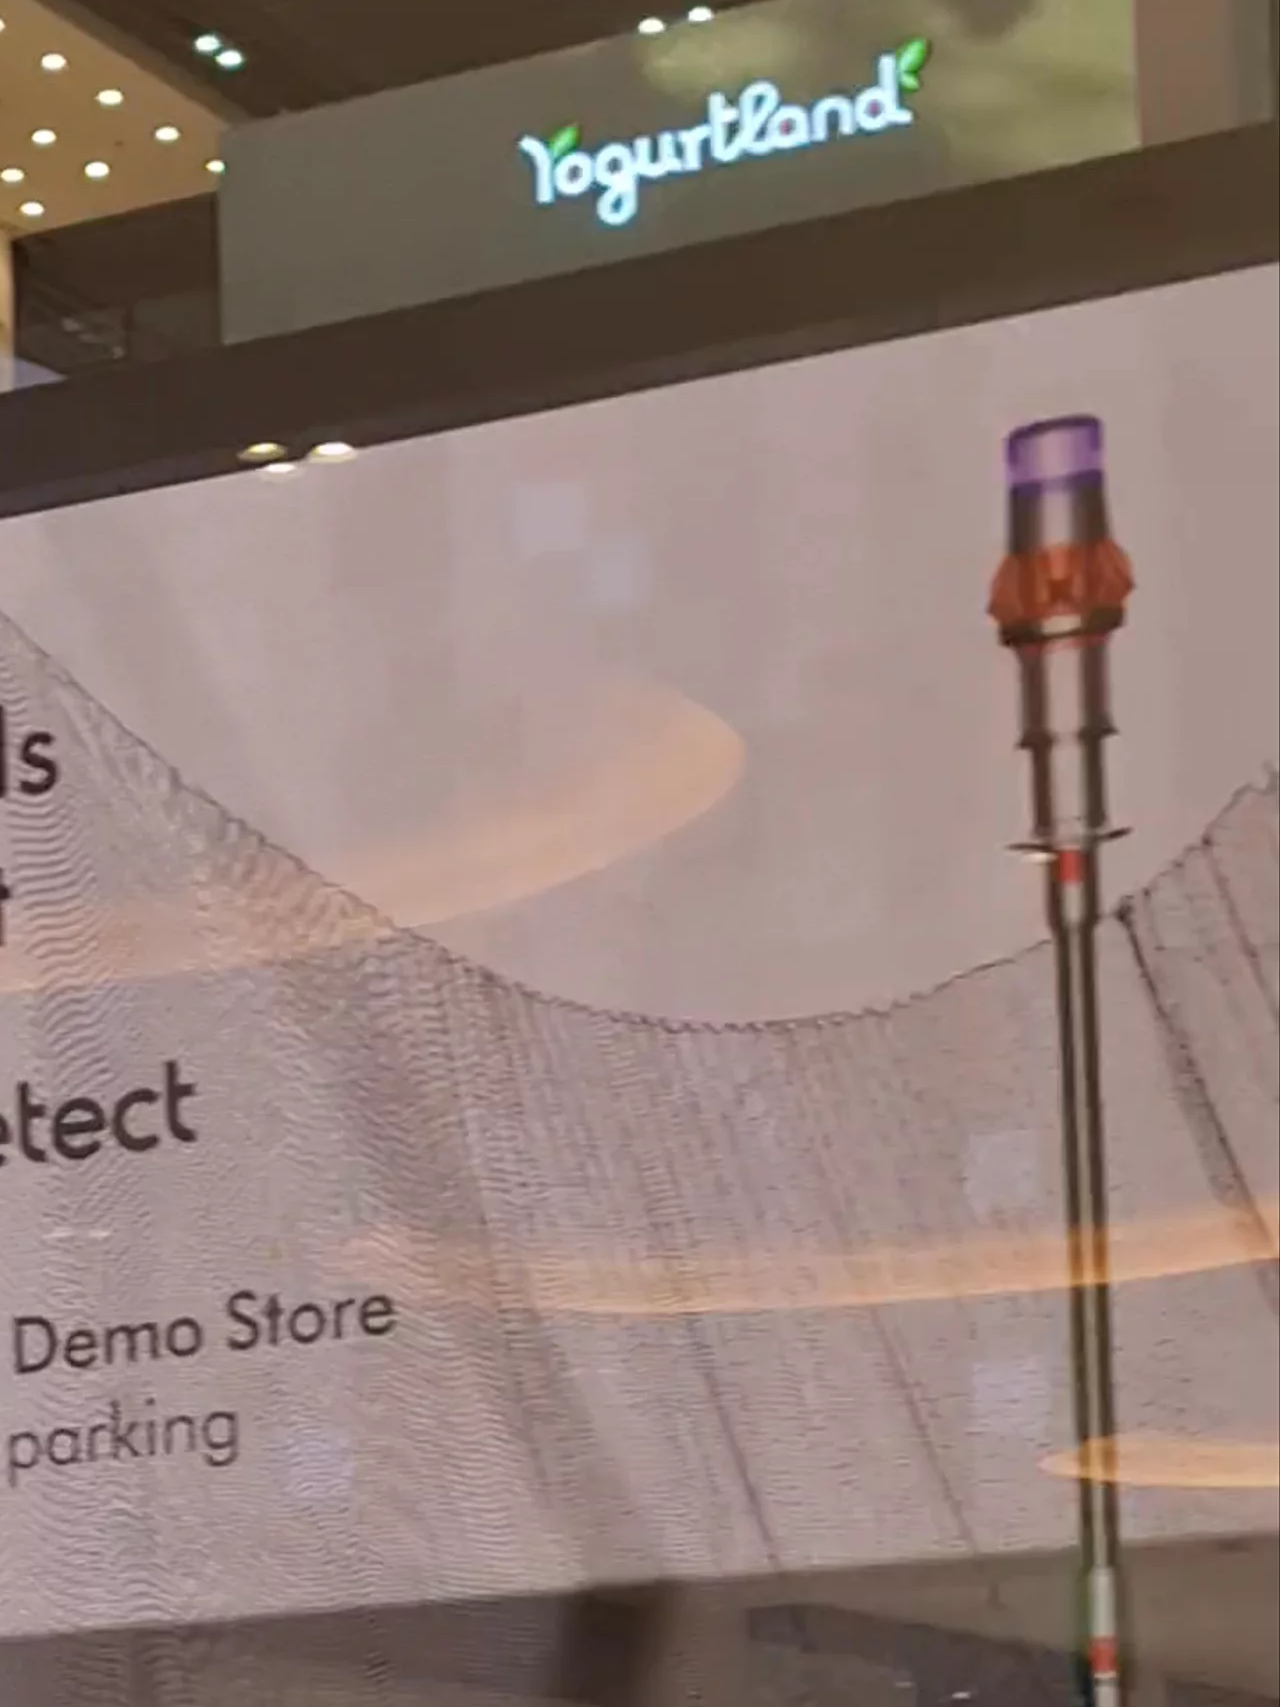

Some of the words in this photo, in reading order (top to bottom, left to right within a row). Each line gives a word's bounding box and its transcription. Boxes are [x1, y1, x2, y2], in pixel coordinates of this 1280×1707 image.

[518, 49, 914, 226] Yogurtland
[13, 1316, 203, 1375] Demo
[226, 1290, 397, 1351] Store
[9, 1399, 238, 1487] parking
